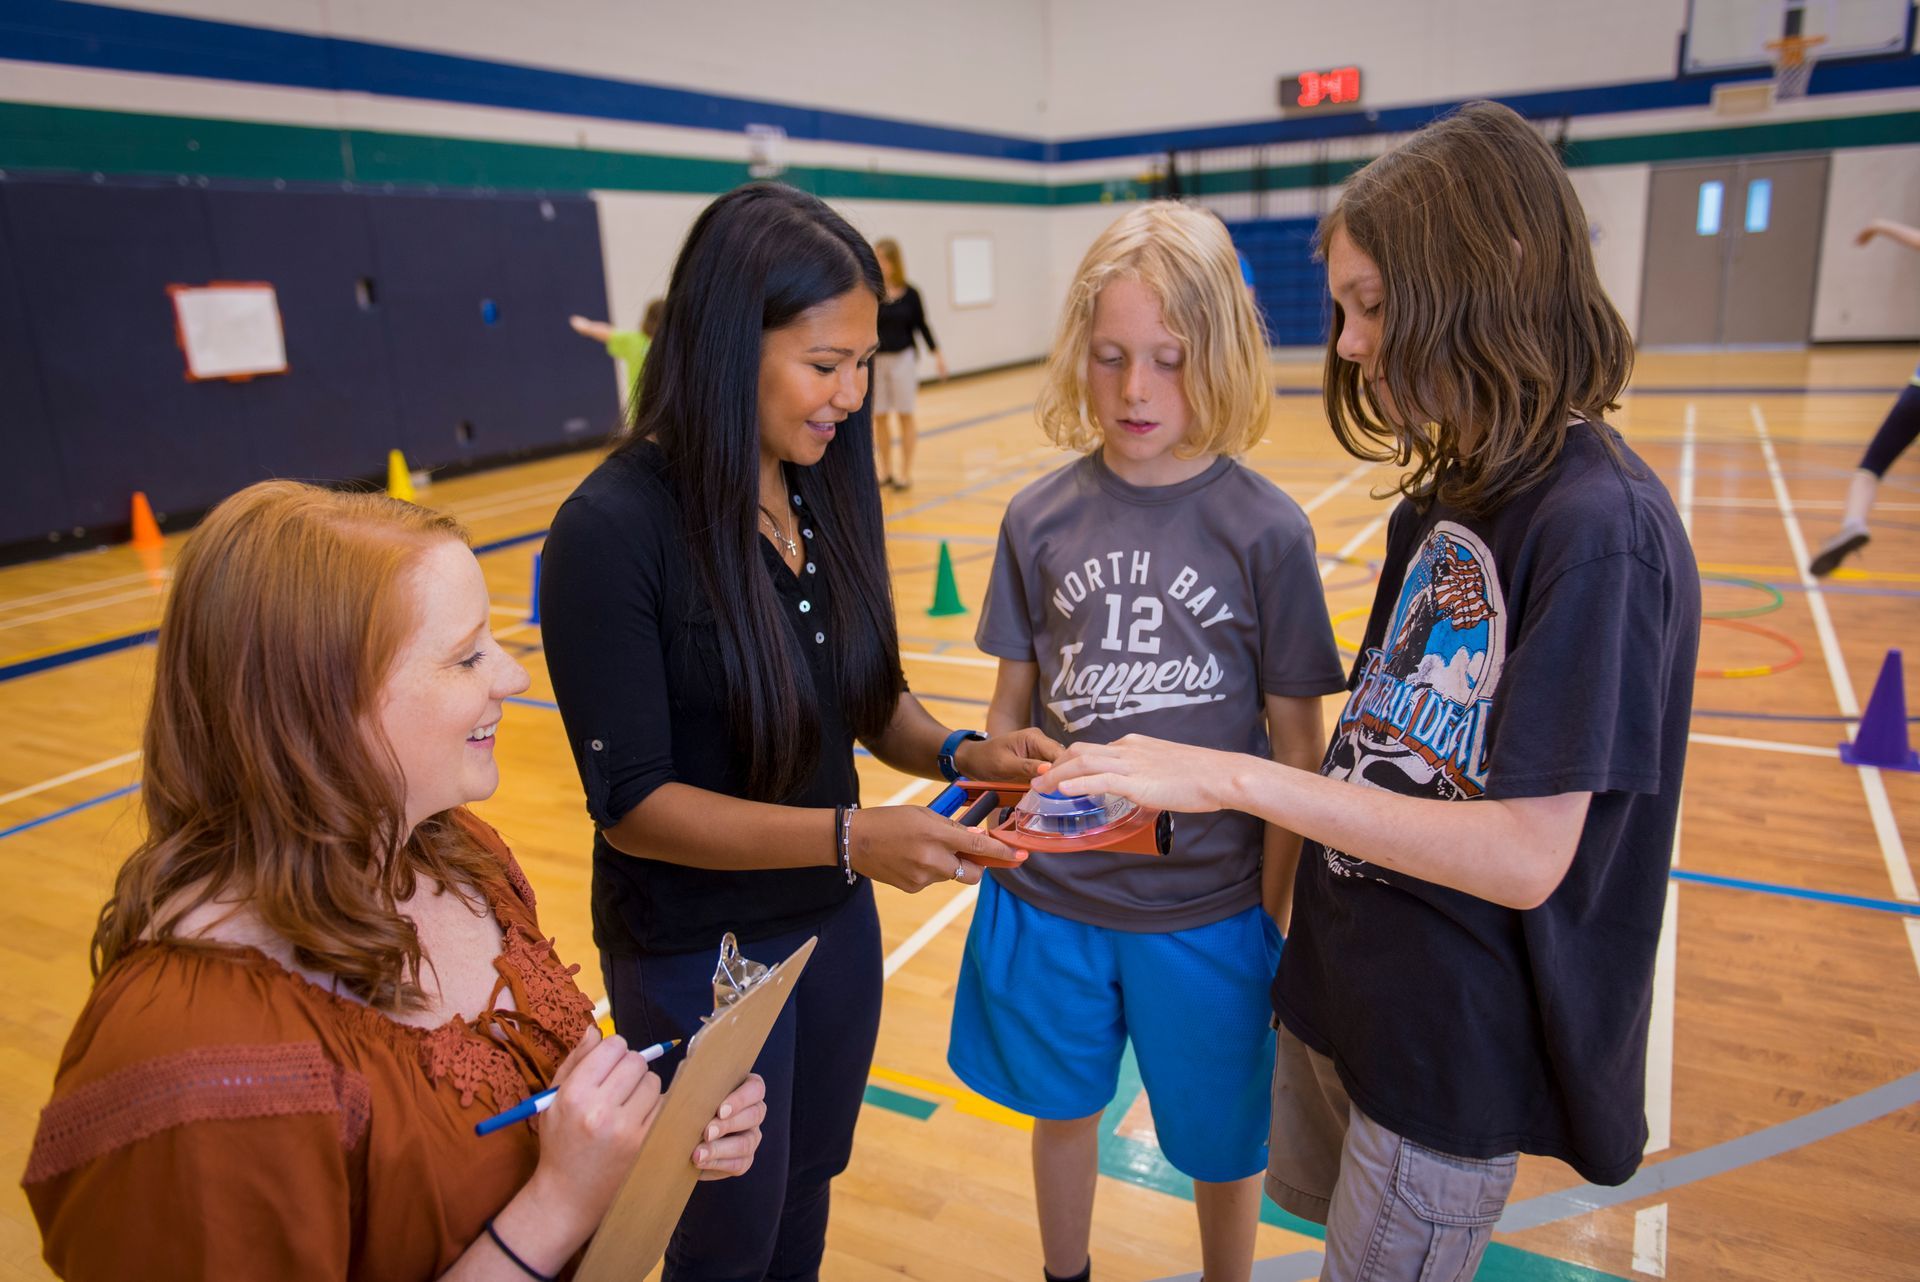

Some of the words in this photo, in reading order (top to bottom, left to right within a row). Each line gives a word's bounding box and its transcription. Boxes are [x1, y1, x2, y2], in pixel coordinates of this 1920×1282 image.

[1053, 550, 1150, 620] NORTH
[1168, 565, 1234, 629] BAY
[1101, 593, 1164, 655] 12
[1050, 642, 1224, 710] Trappers
